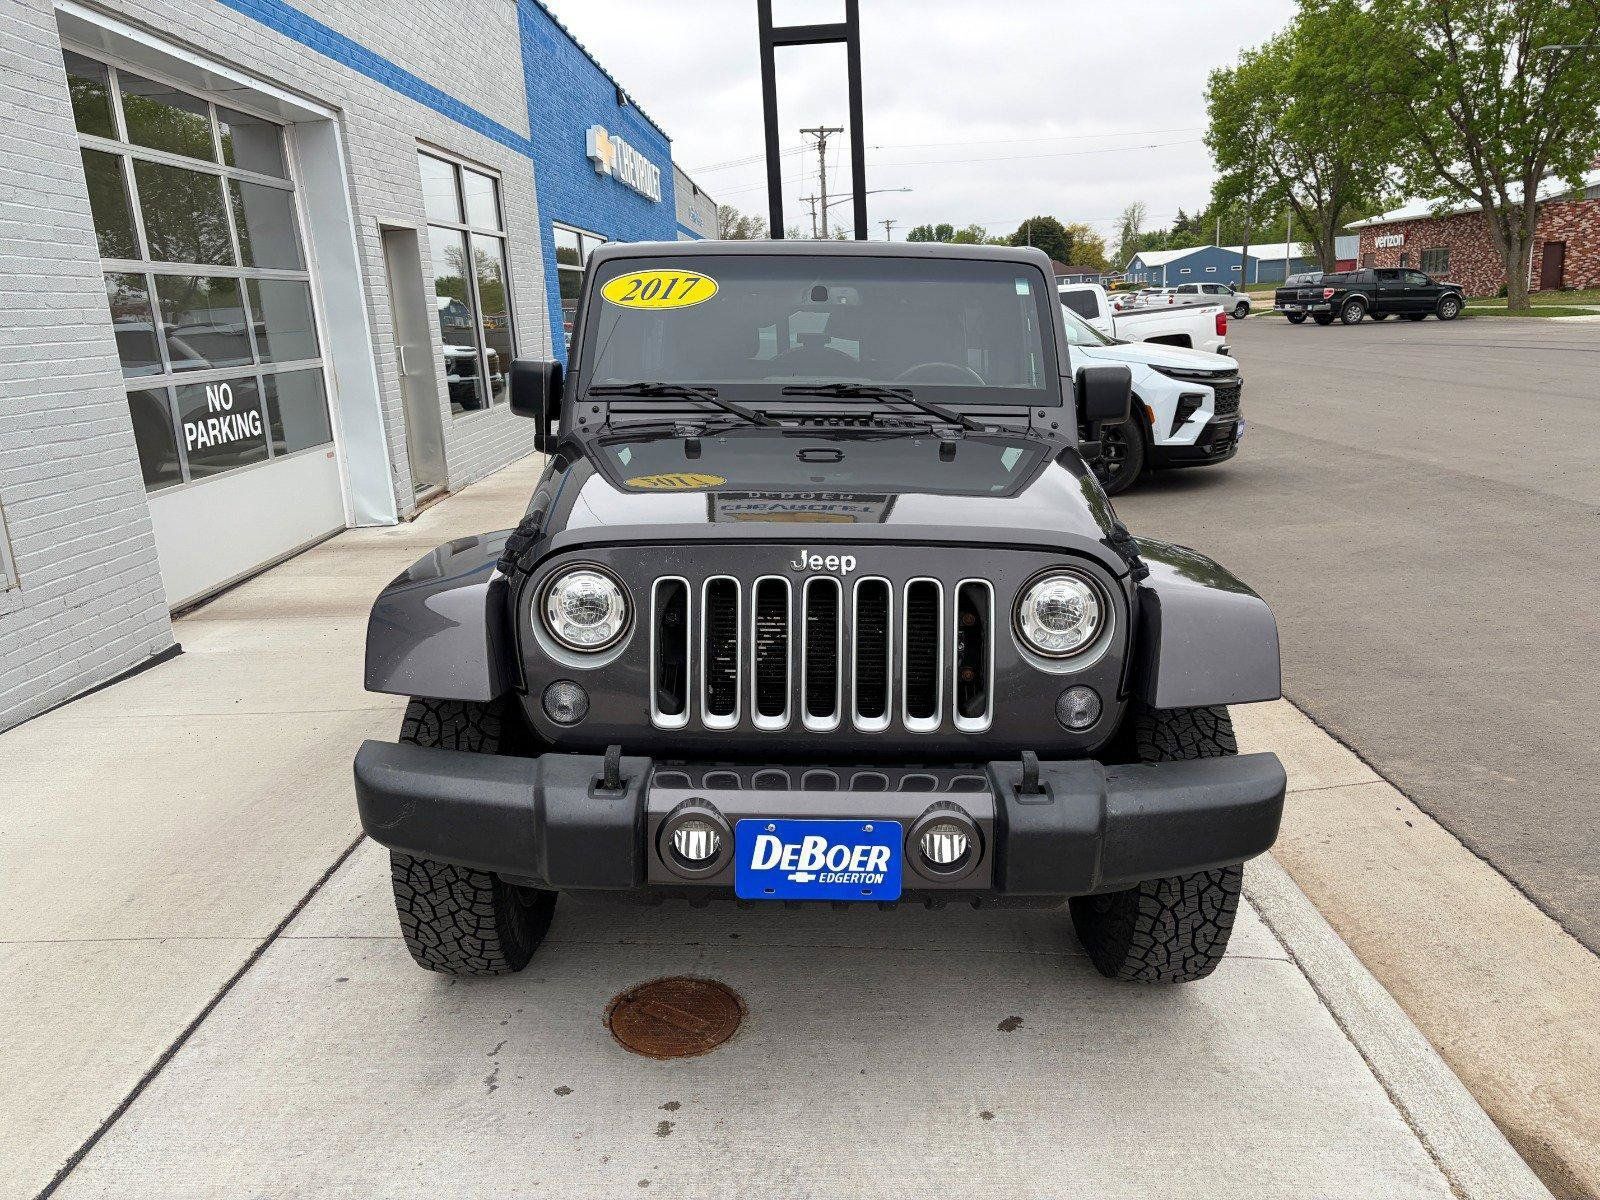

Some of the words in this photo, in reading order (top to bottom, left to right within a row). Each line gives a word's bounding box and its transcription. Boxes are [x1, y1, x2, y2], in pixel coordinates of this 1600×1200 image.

[1374, 231, 1404, 248] verizon
[619, 277, 701, 302] 2017
[205, 382, 233, 413] NO
[183, 409, 262, 452] PARKING
[789, 549, 857, 576] Jeep
[818, 872, 884, 884] EDGERTON
